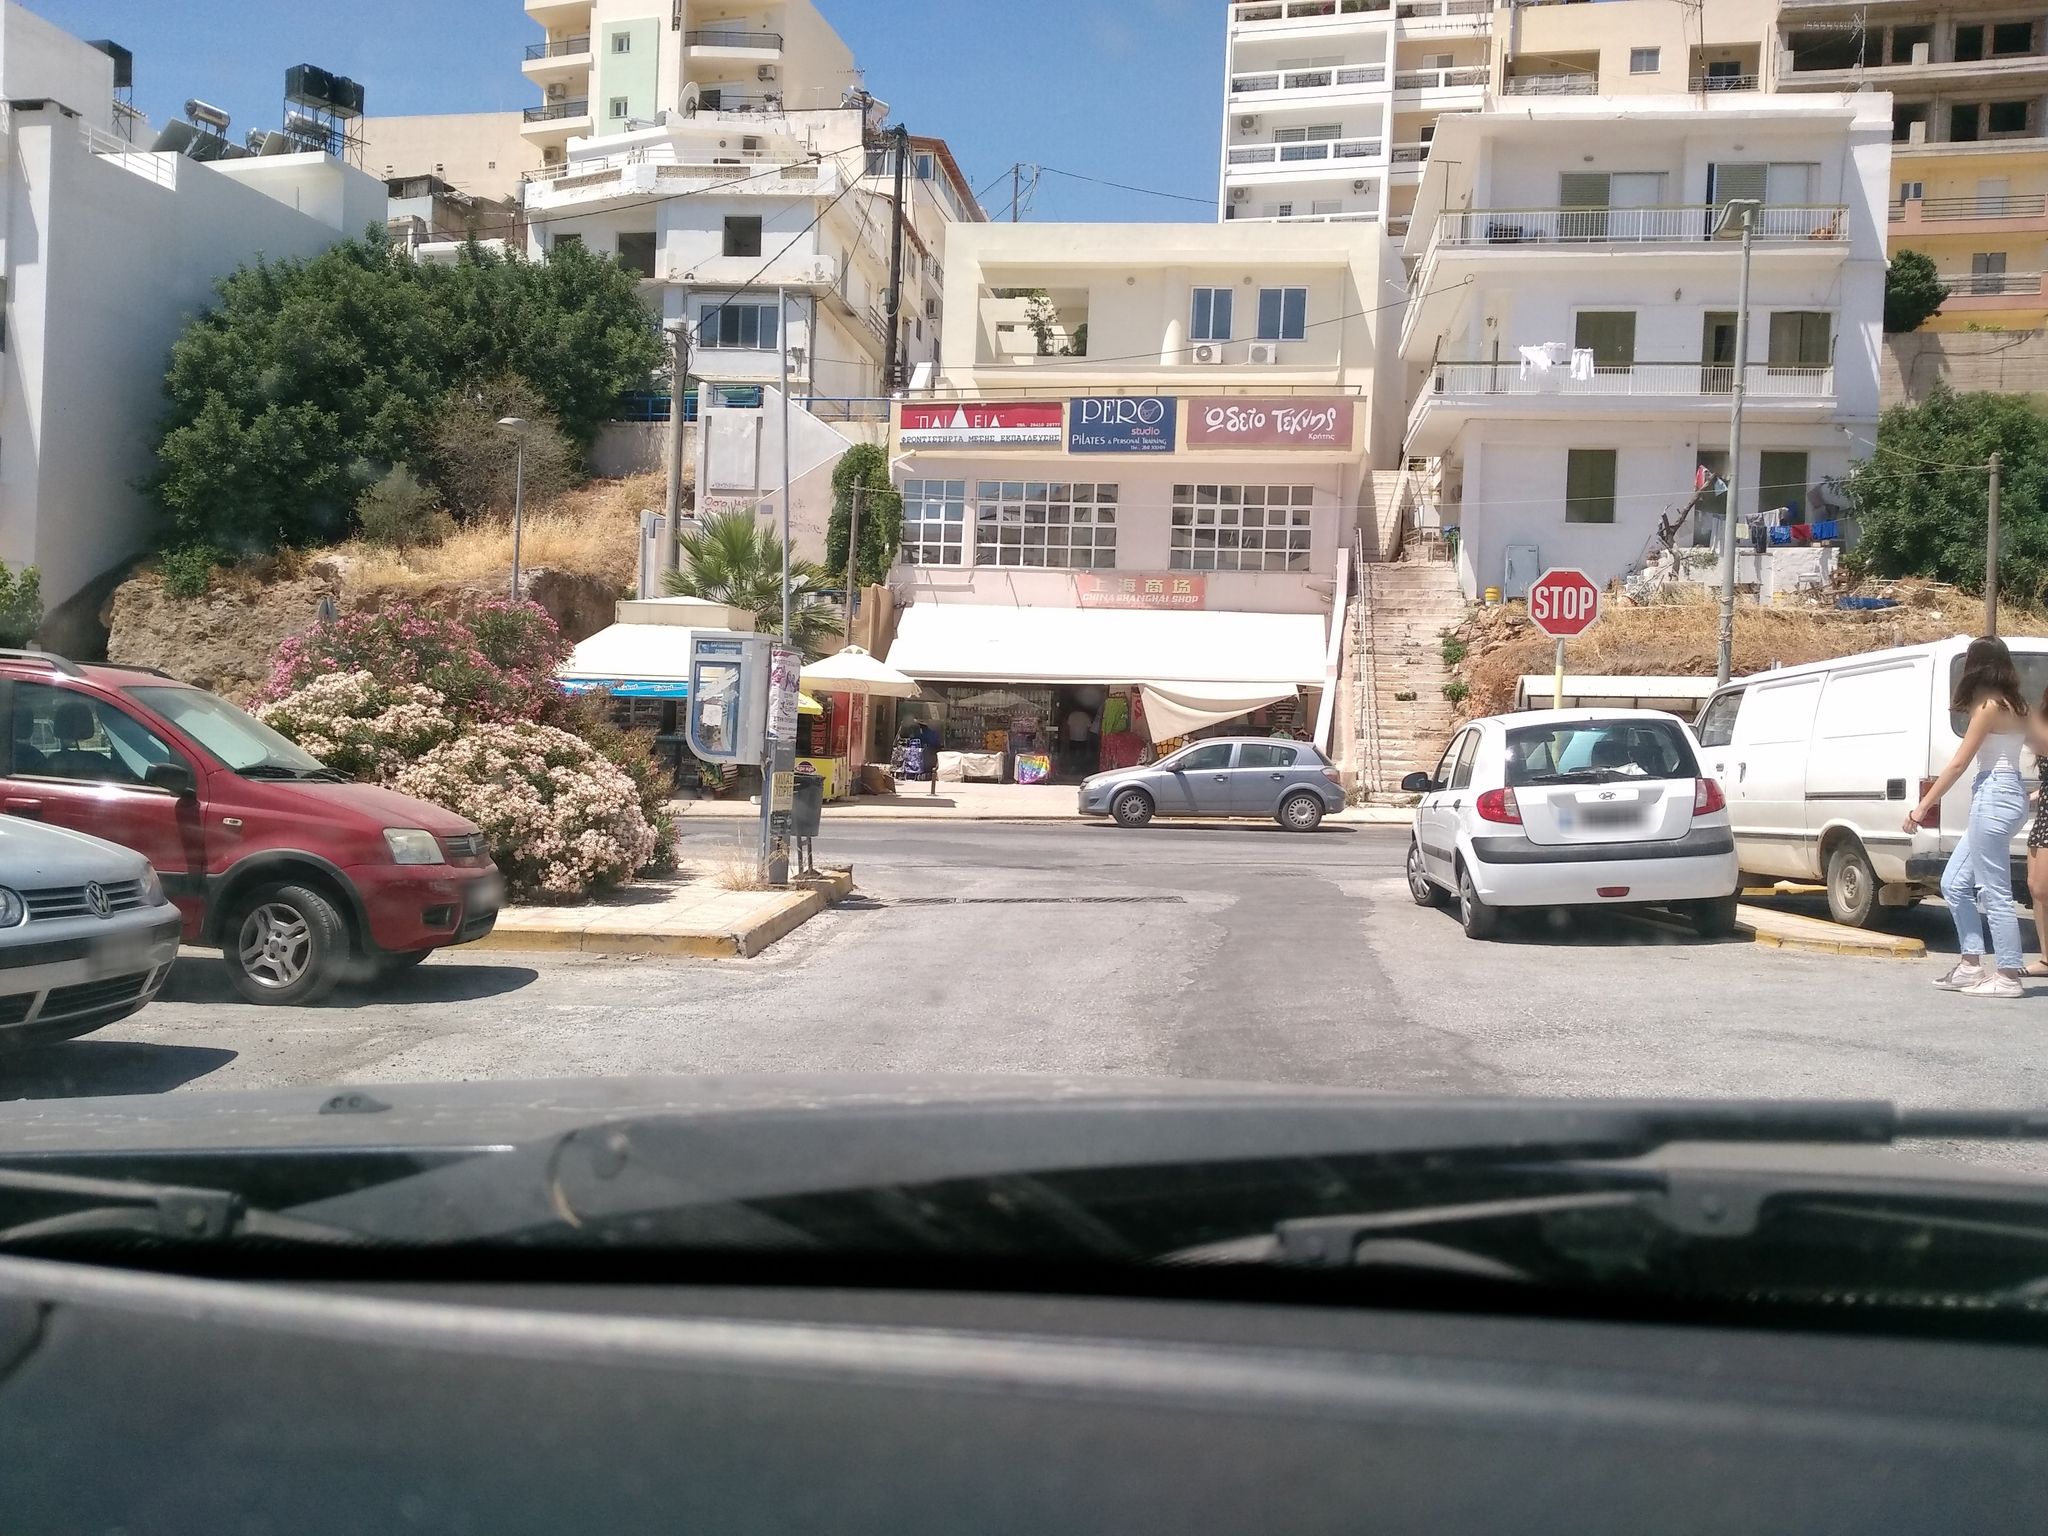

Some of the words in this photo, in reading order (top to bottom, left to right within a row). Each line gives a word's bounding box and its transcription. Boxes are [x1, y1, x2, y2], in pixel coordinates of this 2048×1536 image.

[1081, 398, 1164, 424] PERO
[1131, 427, 1160, 436] studio
[1000, 434, 1060, 442] ΕΚΠΑΙΔΕΥΣΗΣ
[1083, 593, 1114, 602] CHINA
[1116, 594, 1168, 603] SHANGHAI
[1172, 595, 1199, 603] SHOP
[1535, 586, 1594, 620] STOP
